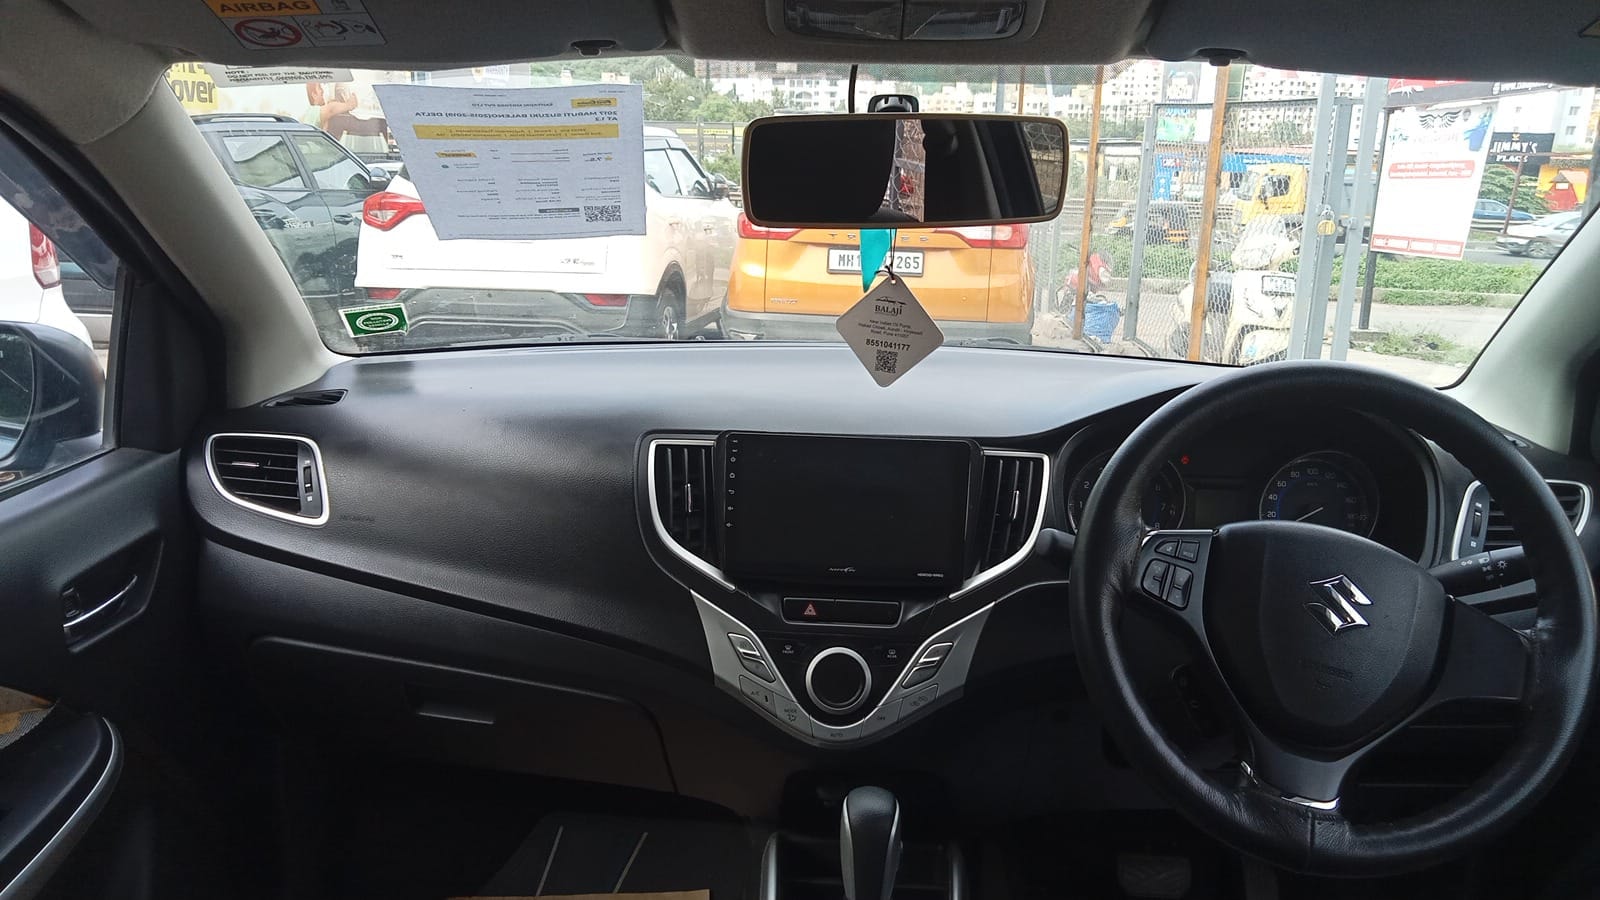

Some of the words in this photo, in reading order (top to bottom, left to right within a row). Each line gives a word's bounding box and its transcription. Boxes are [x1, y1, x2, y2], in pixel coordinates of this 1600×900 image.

[219, 0, 311, 13] AIRBAG
[1490, 141, 1538, 154] JIMMY'S
[865, 338, 911, 352] 8551041177
[1083, 481, 1090, 489] 2
